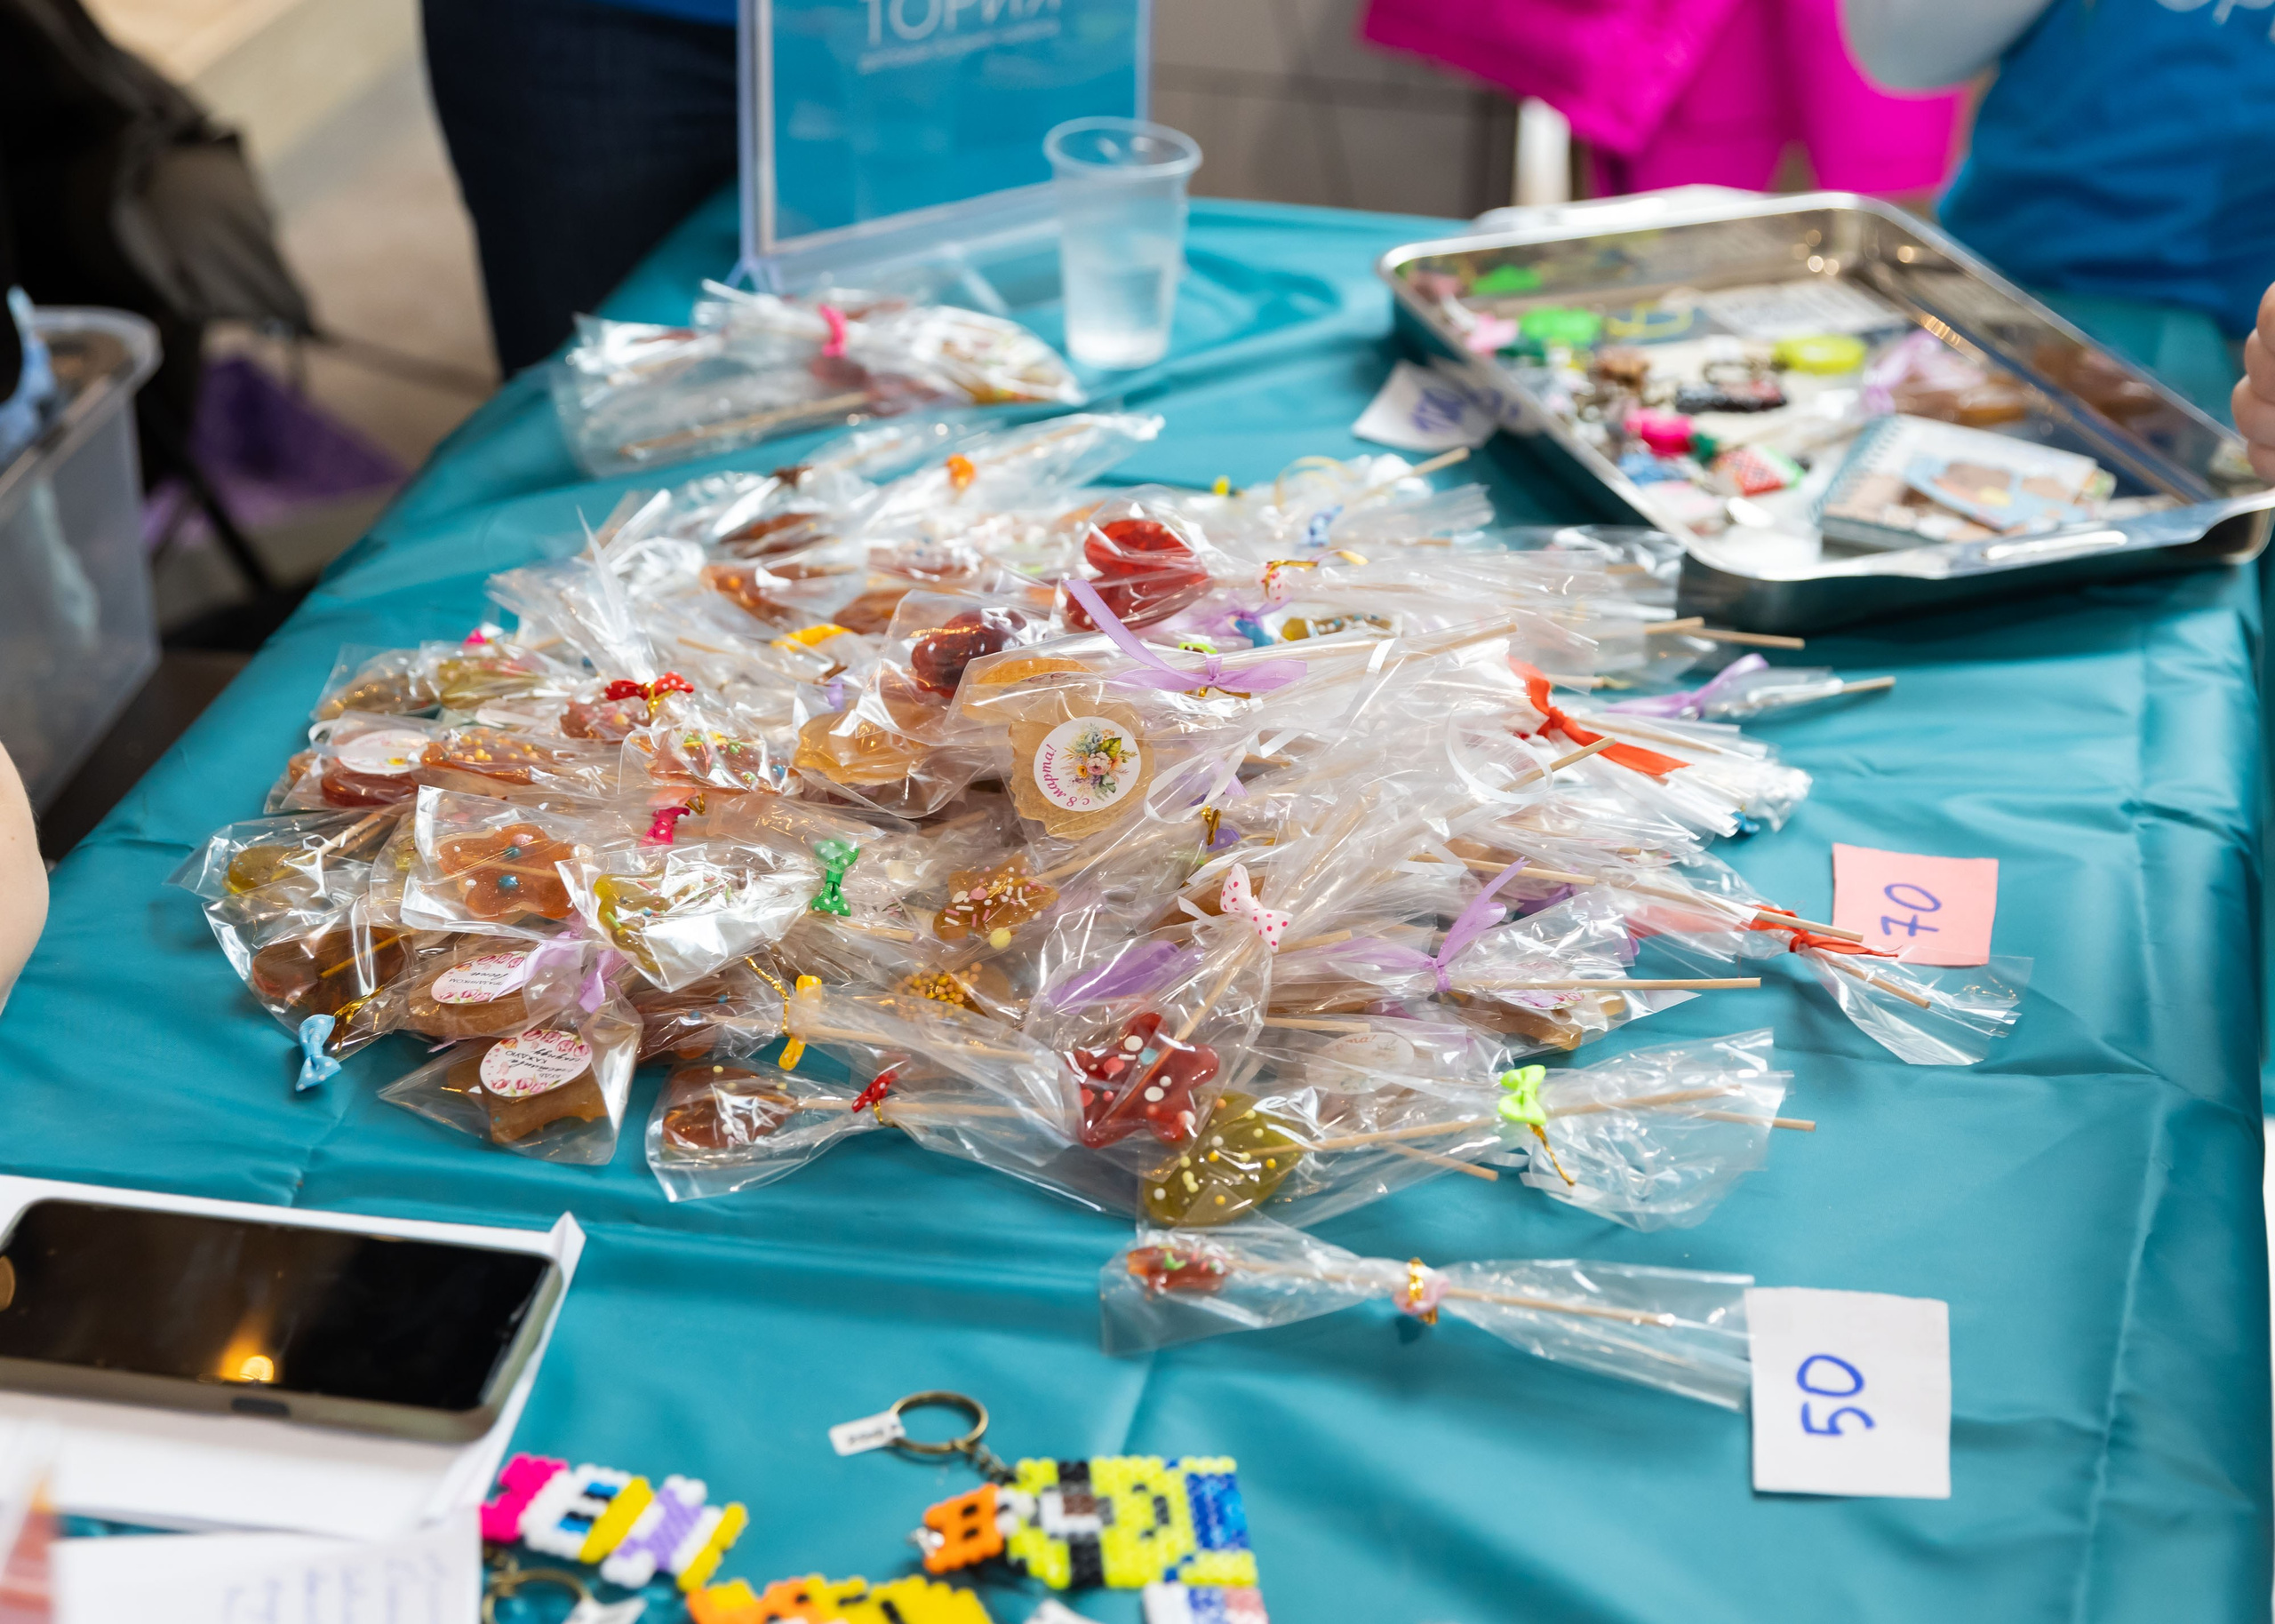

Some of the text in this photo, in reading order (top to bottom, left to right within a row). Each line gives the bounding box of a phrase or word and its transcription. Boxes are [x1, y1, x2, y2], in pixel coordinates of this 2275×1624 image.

[859, 0, 1062, 44] ТОР
[1042, 744, 1066, 798] марта!
[1066, 796, 1078, 808] 8
[1880, 883, 1943, 937] 70
[1796, 1353, 1876, 1437] 50
